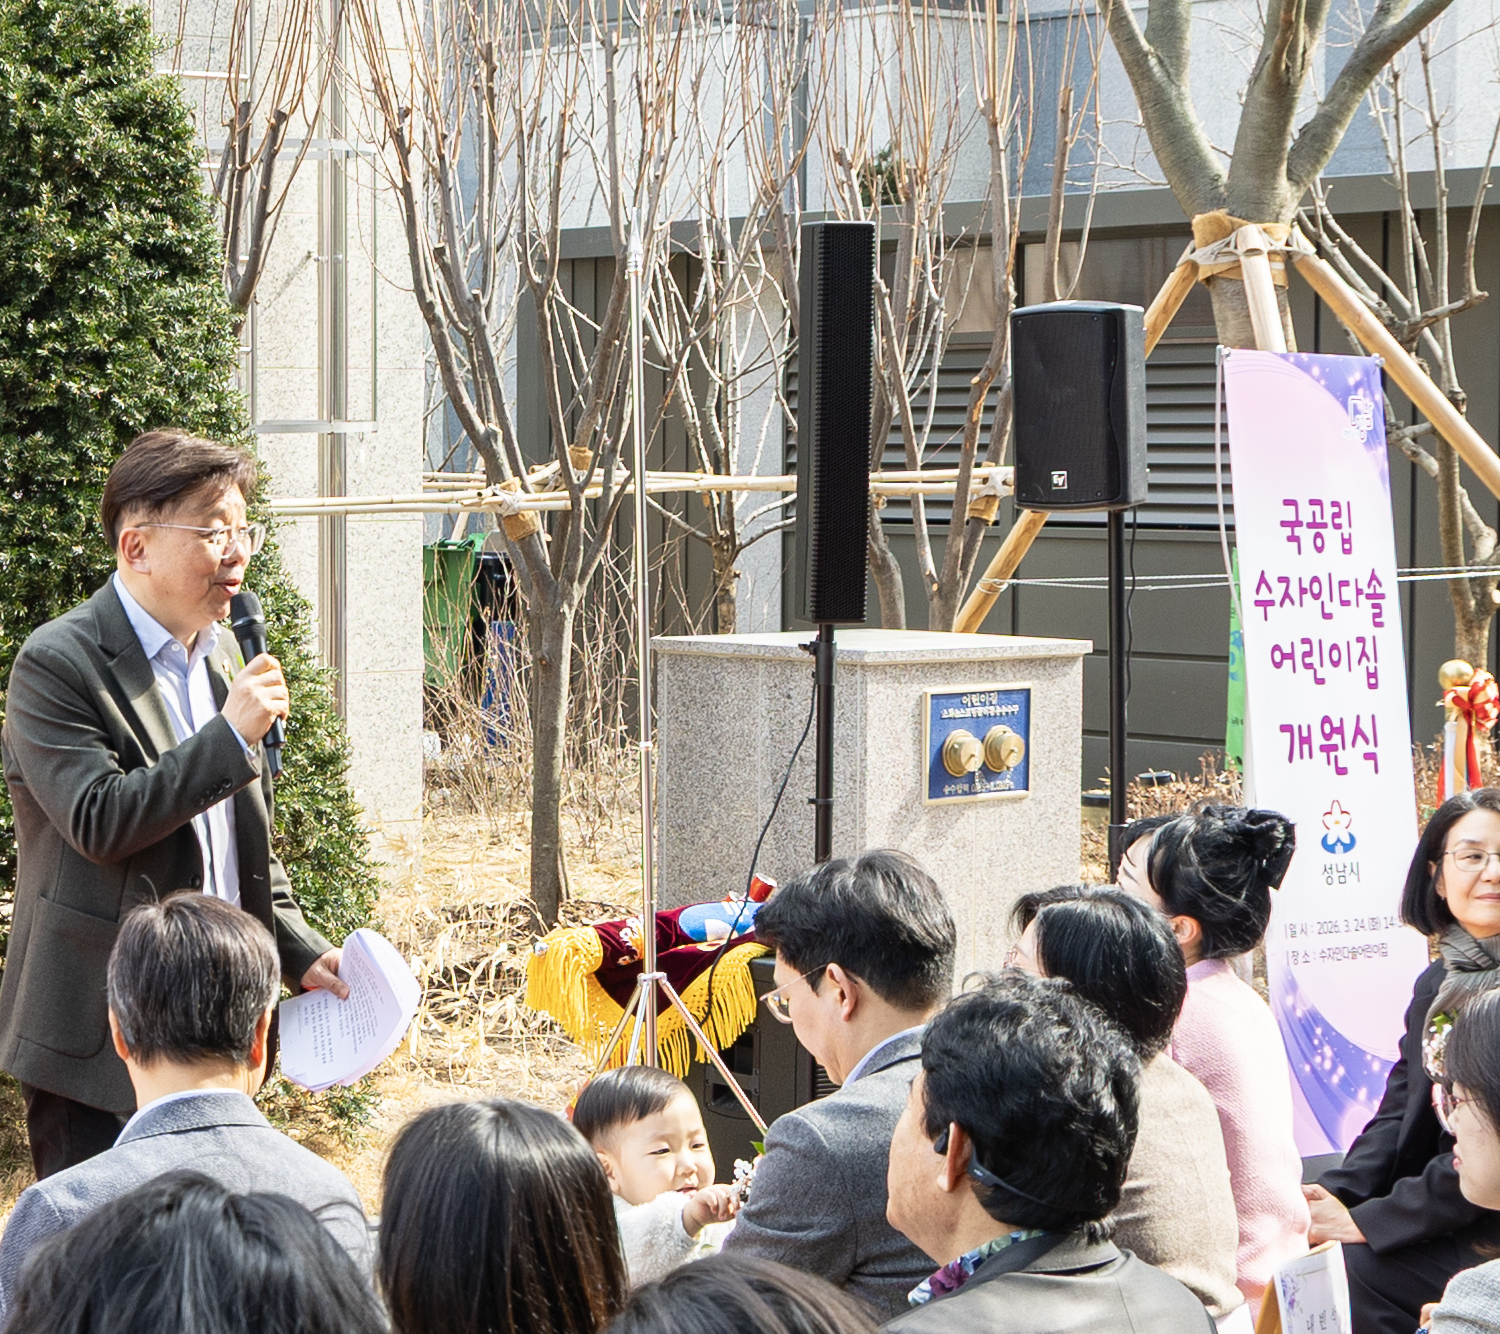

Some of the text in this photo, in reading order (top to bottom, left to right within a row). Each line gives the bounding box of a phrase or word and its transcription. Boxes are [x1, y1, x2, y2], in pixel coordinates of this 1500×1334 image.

[1280, 498, 1353, 556] 국공립
[1254, 568, 1387, 628] 수자인다솔
[1270, 635, 1379, 690] 어린이집
[1279, 714, 1379, 775] 개원식
[1321, 861, 1361, 885] 성남시
[1319, 942, 1389, 963] 수자인다솔어린이집
